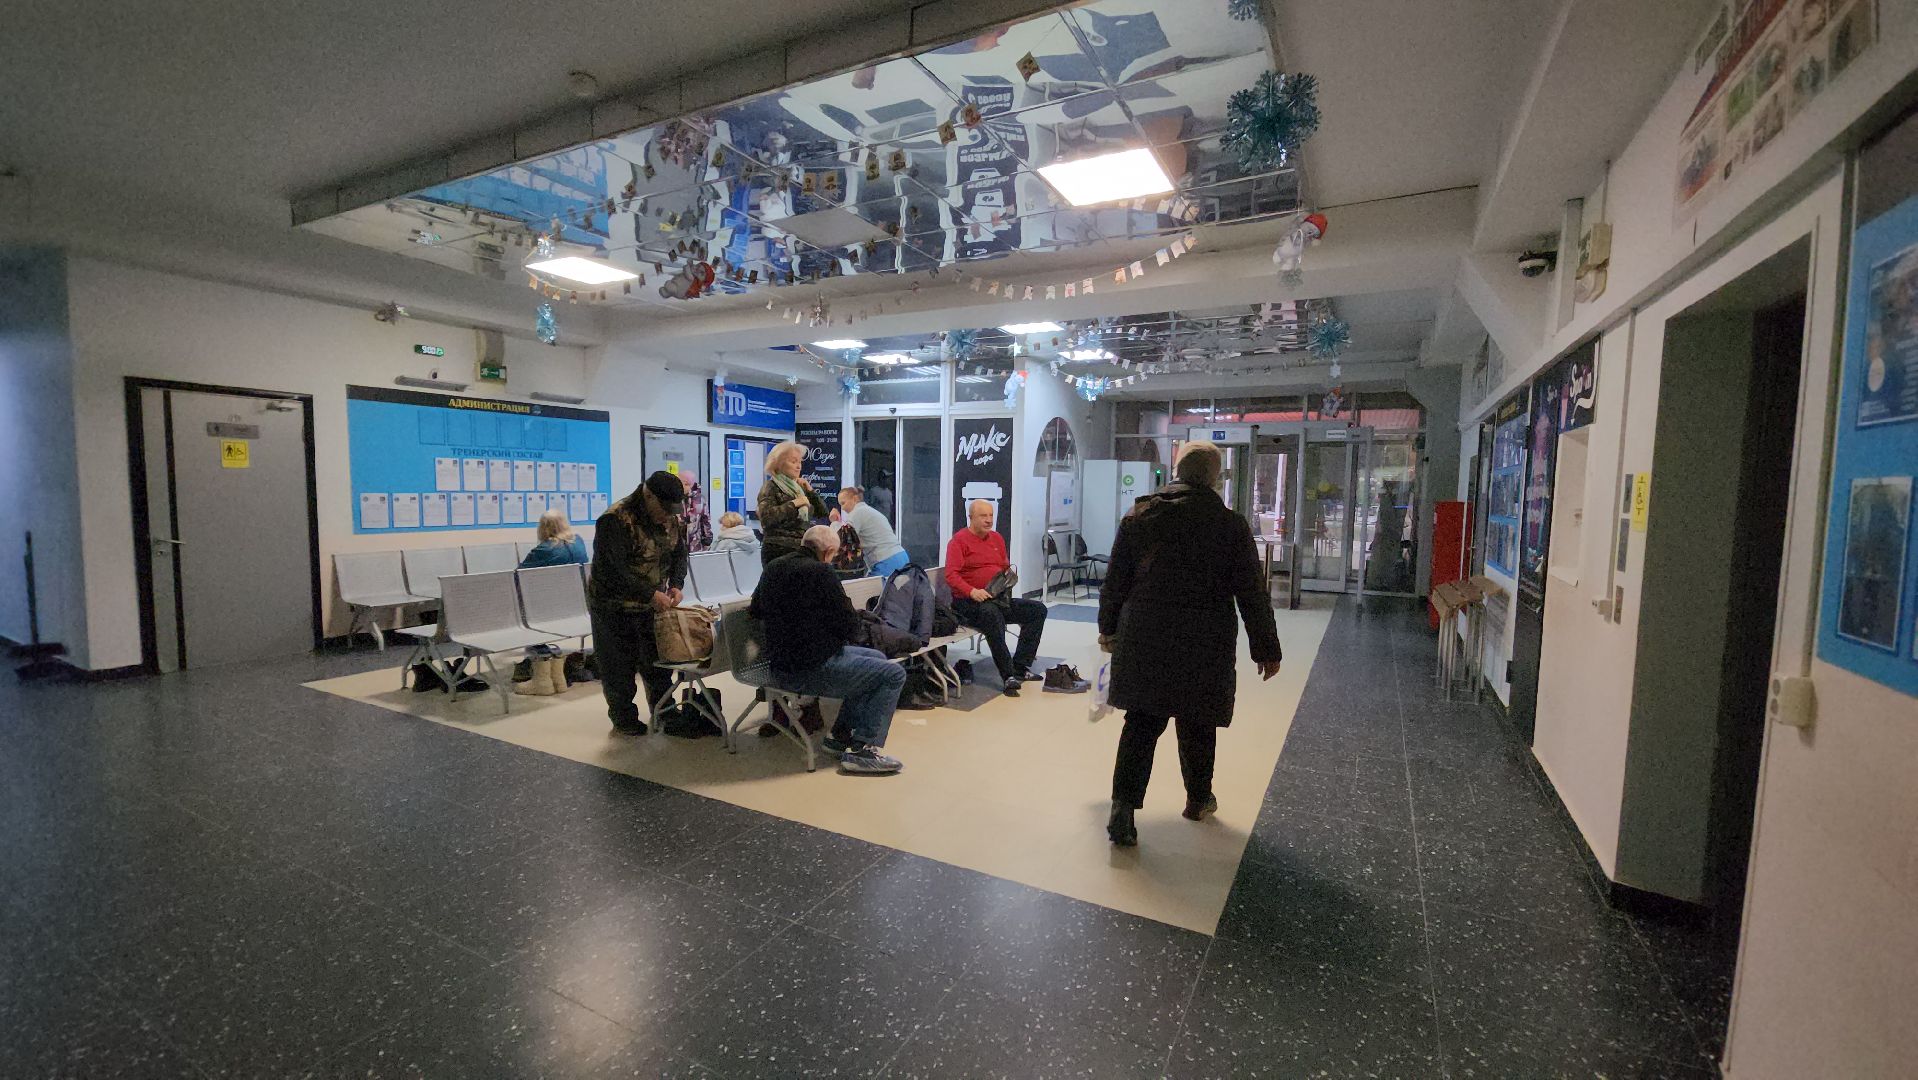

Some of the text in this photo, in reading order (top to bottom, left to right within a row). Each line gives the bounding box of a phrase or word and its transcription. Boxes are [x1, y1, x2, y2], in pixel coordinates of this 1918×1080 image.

[448, 399, 530, 413] АДМИНИСТРАЦИЯ
[450, 447, 544, 459] ТРЕНЕРСКИЙ СОСТАВ
